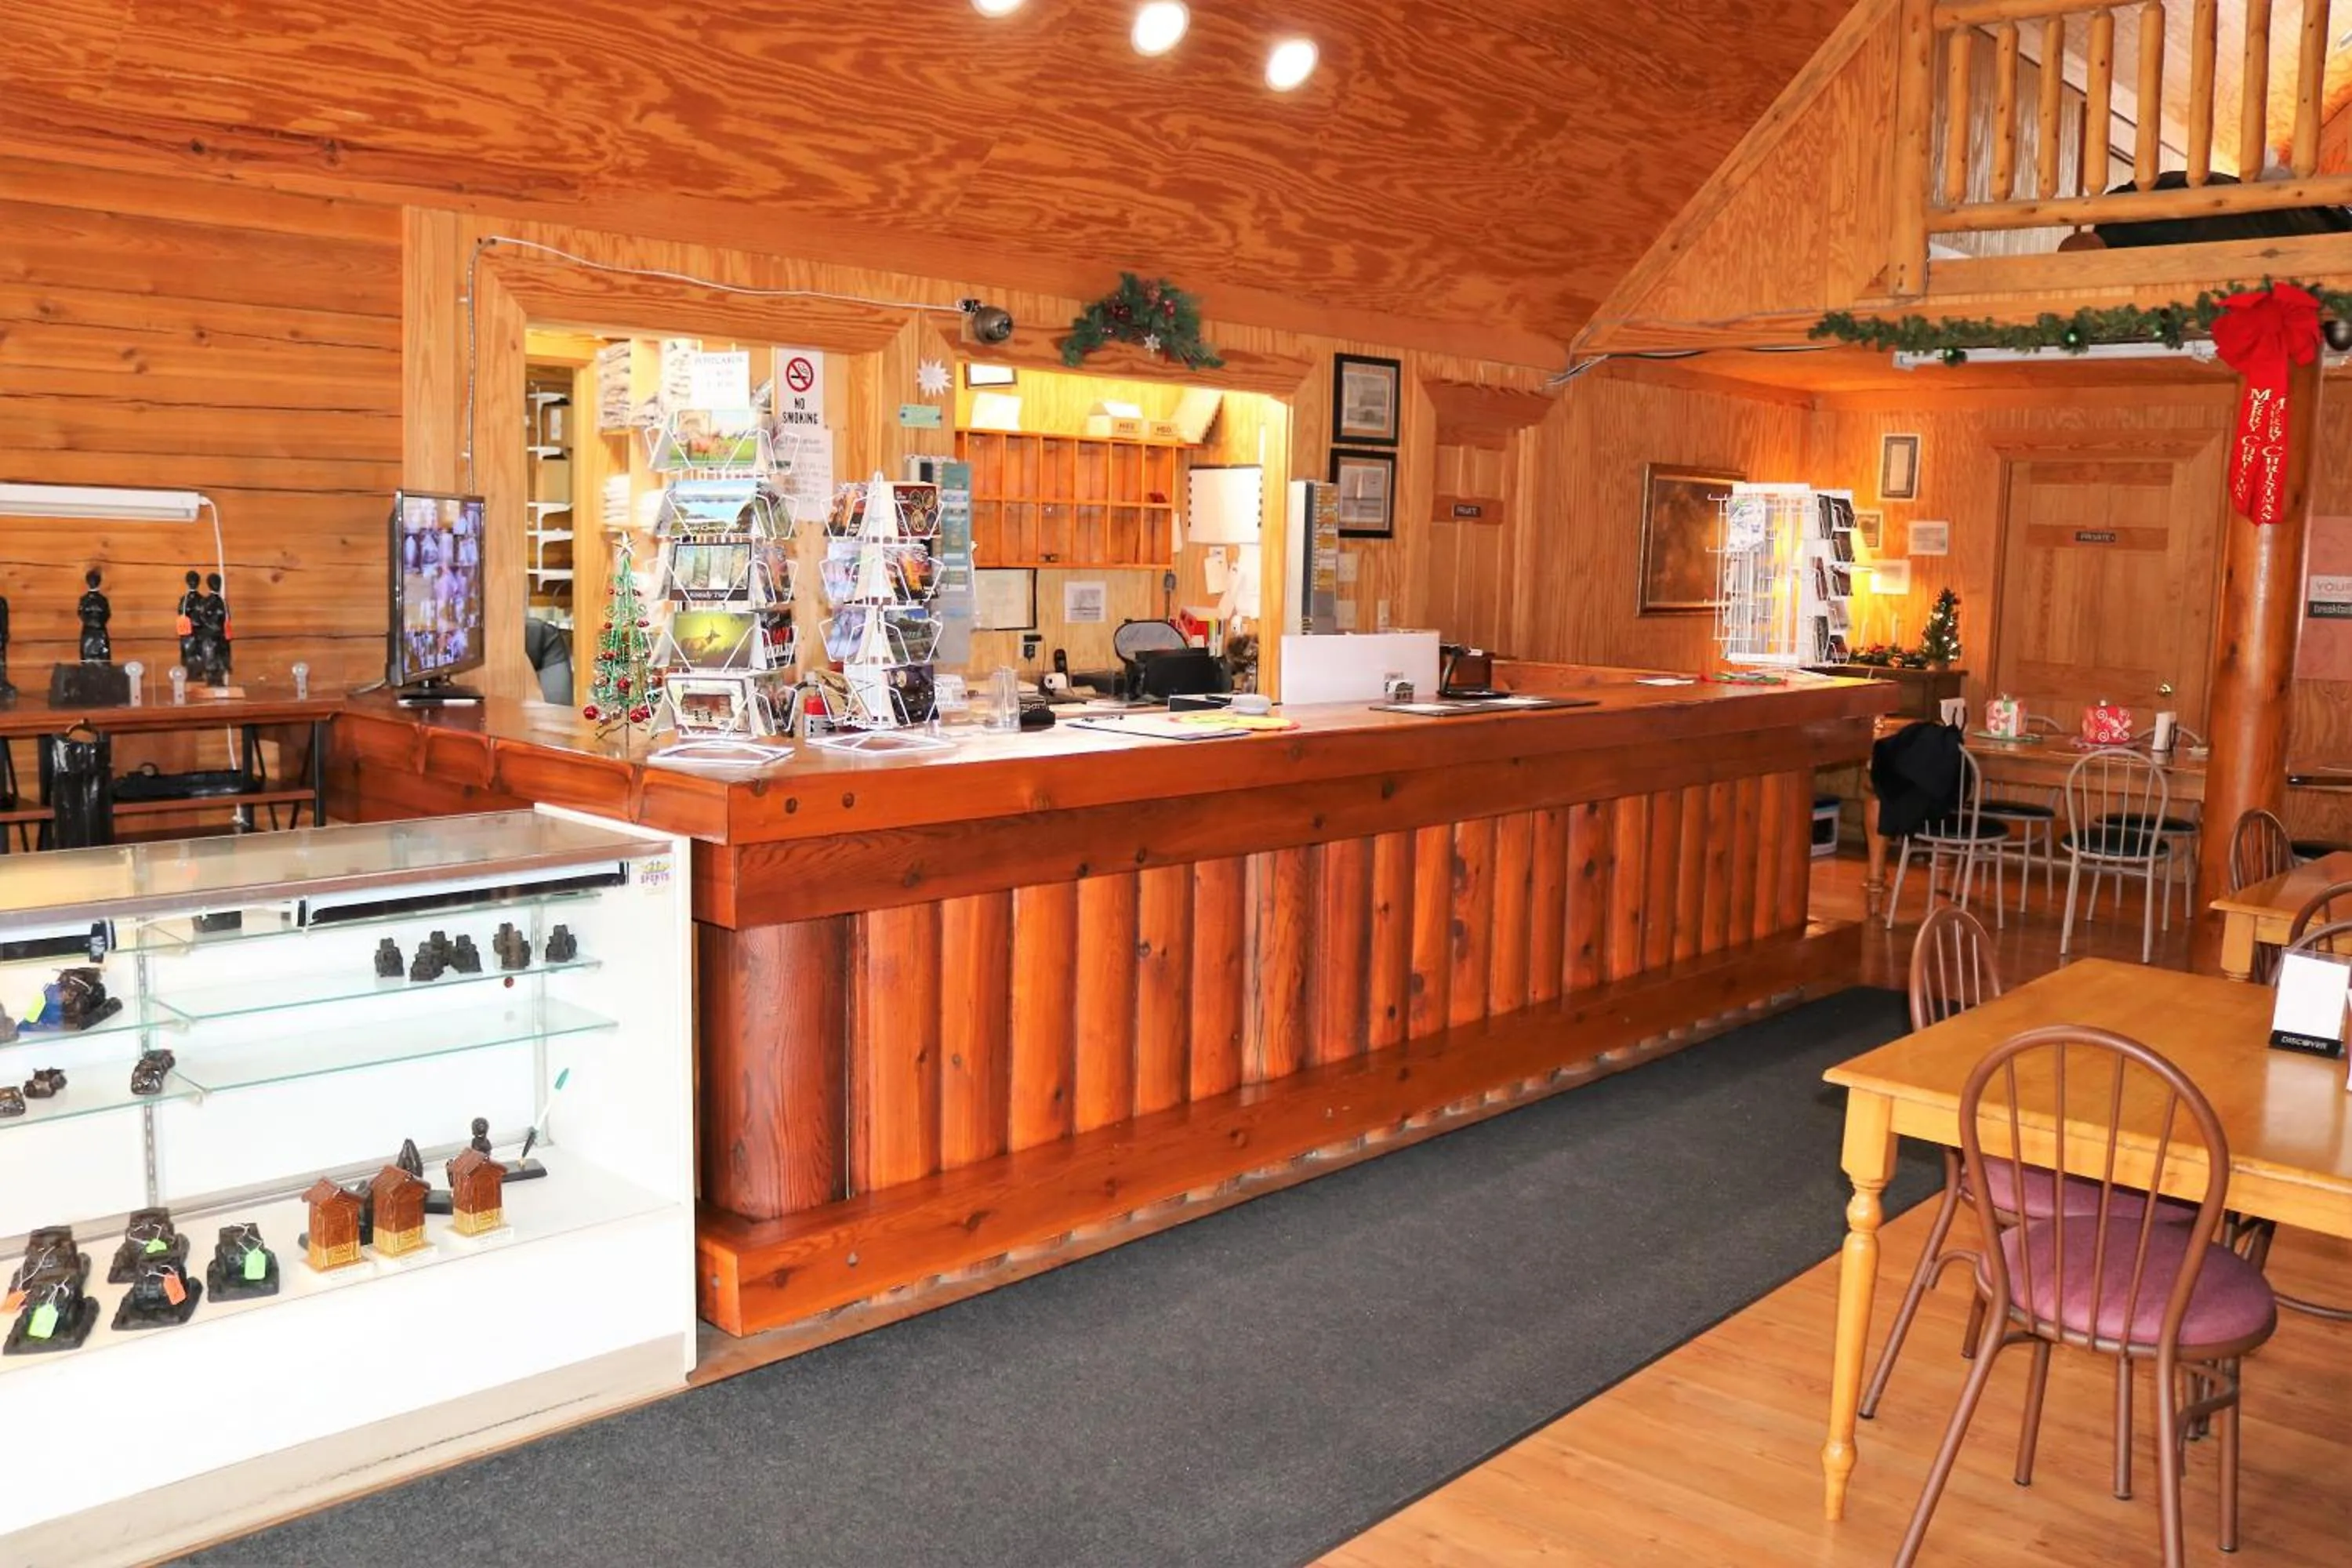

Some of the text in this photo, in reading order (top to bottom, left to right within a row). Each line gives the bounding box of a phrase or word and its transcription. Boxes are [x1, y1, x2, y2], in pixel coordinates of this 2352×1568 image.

[794, 397, 805, 409] NO
[2248, 388, 2272, 432] MERRY
[782, 412, 818, 425] SMOKING
